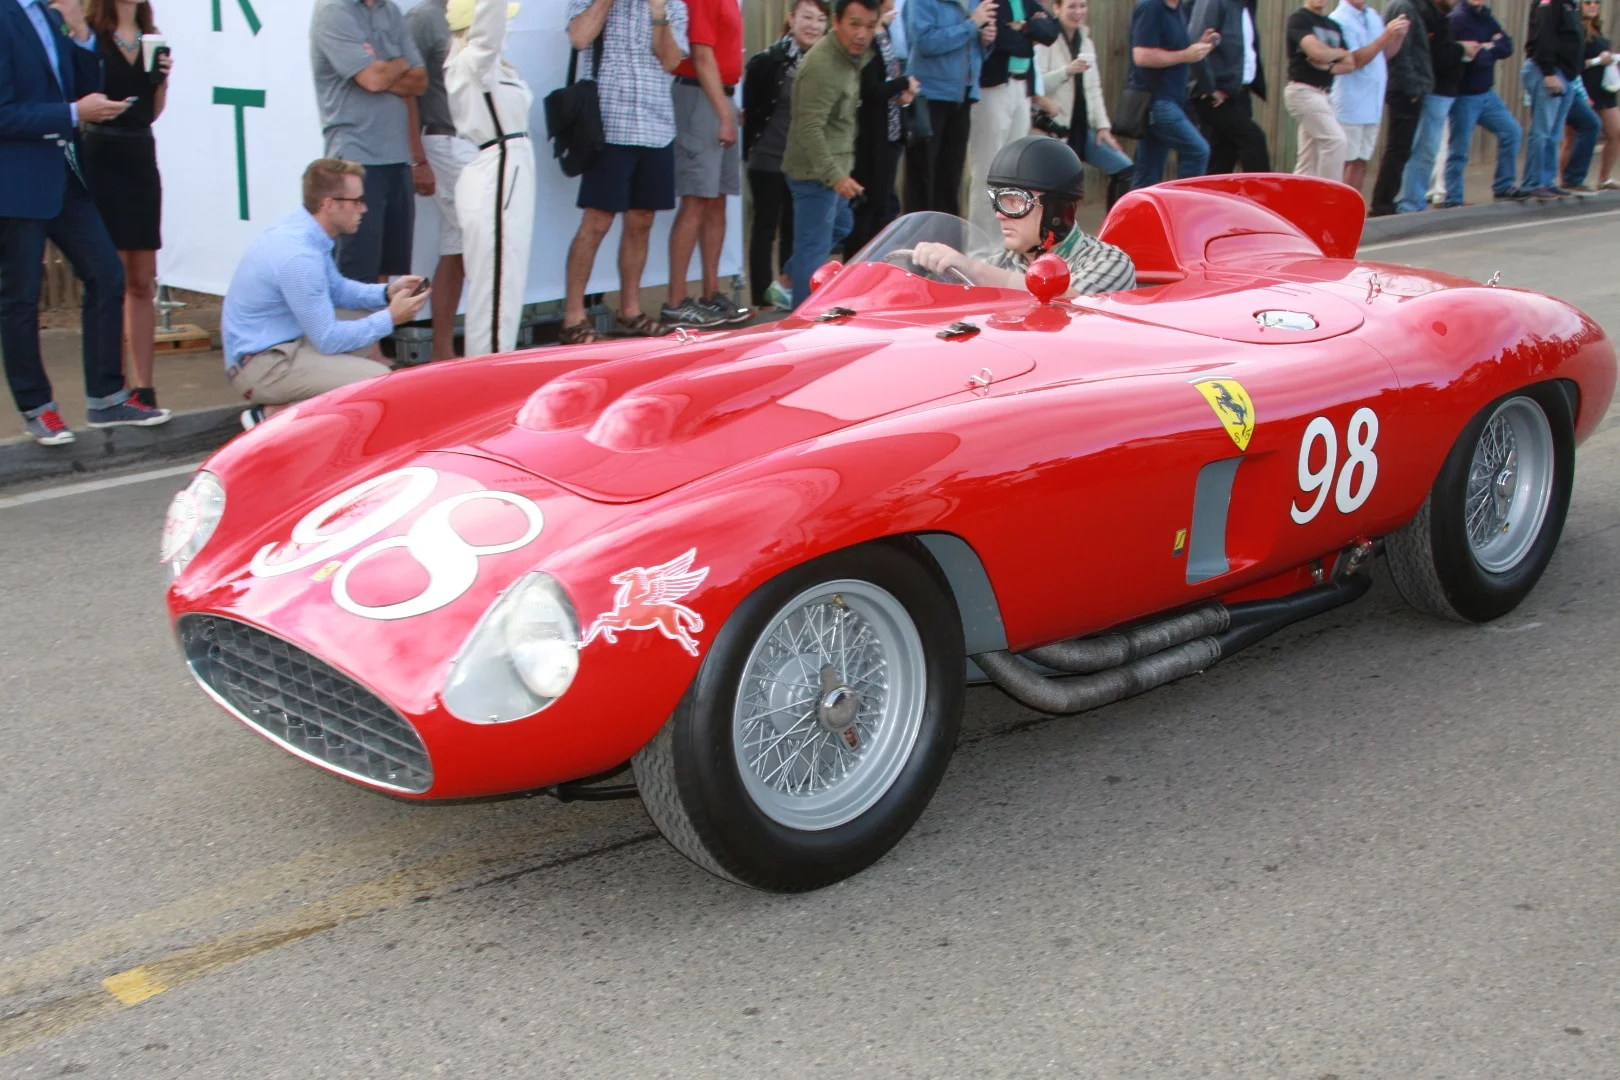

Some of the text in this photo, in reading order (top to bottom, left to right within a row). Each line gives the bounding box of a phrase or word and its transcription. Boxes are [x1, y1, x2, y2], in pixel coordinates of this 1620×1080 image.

[211, 0, 266, 221] T
[251, 465, 544, 621] 98
[1290, 406, 1379, 525] 98
